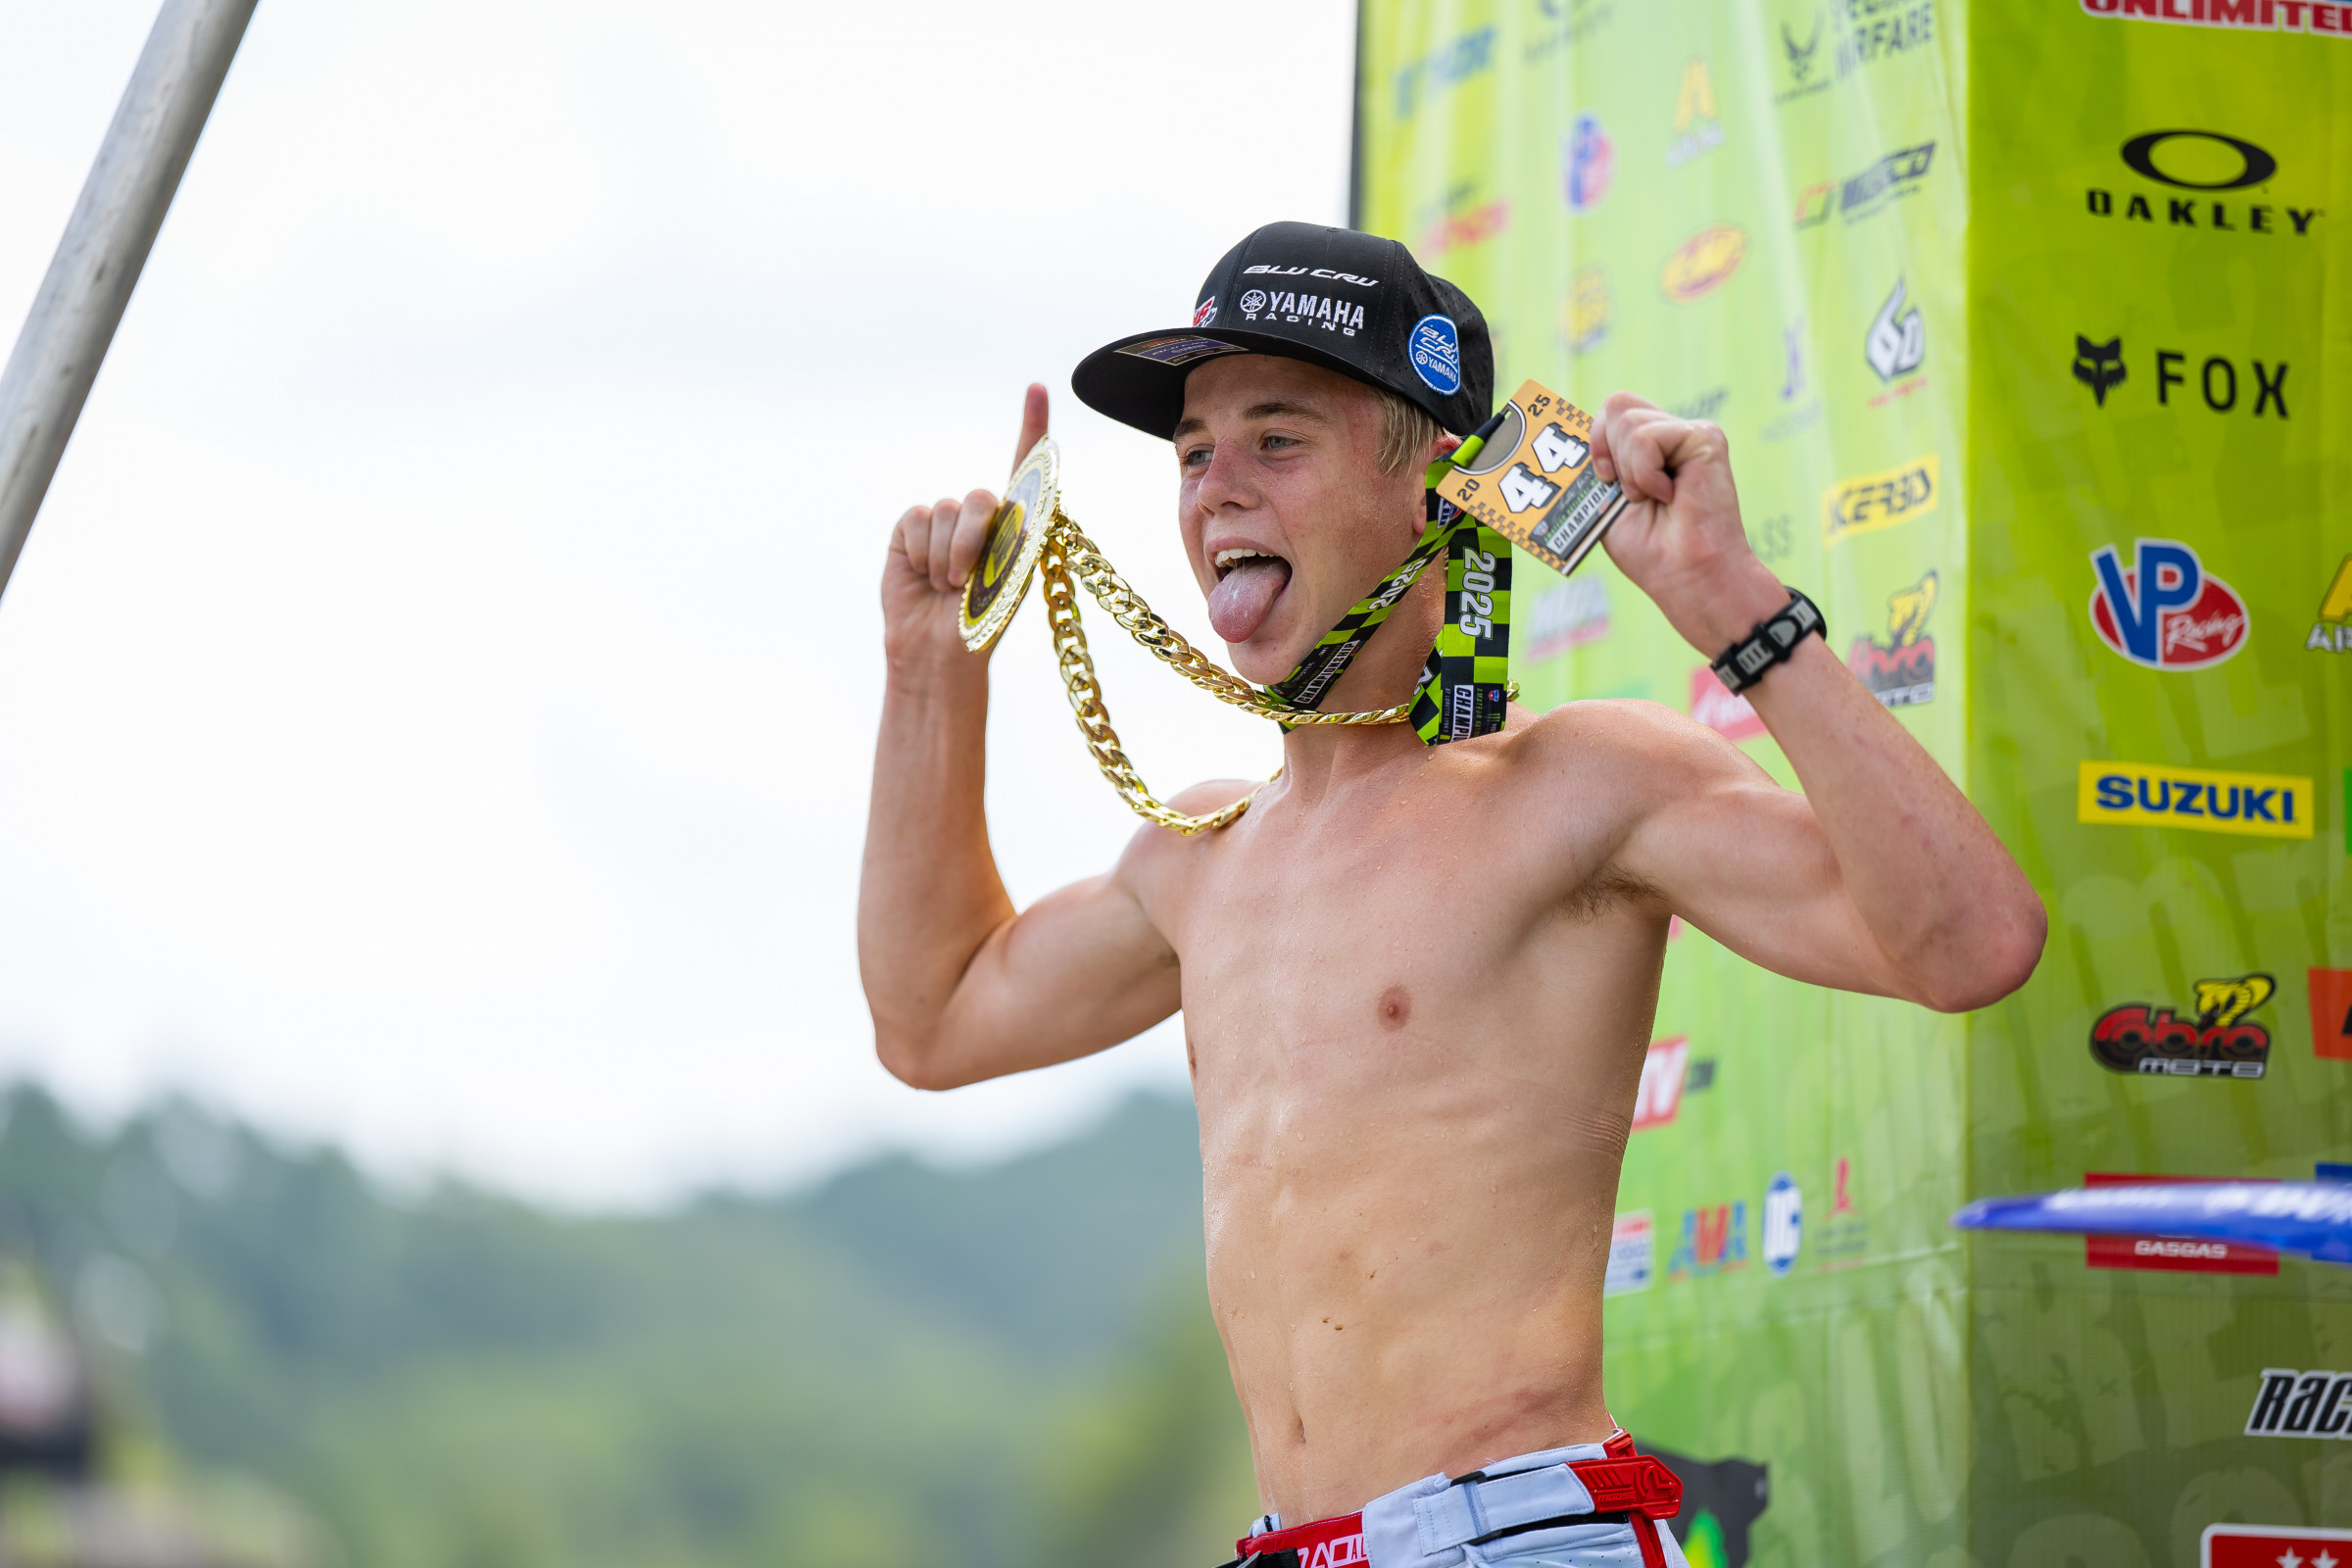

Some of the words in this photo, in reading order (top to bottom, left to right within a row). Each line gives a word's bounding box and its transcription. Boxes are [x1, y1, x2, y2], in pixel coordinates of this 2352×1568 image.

[2086, 188, 2316, 235] OAKLEY
[1243, 265, 1308, 274] BLU
[1309, 269, 1379, 287] CRU
[1245, 313, 1356, 336] RACING
[1269, 291, 1364, 329] YAMAHA
[1527, 394, 1550, 418] 25
[2156, 348, 2289, 419] FOX
[1456, 478, 1481, 502] 20
[1368, 558, 1429, 610] 2025
[1460, 547, 1497, 640] 2025
[2091, 539, 2201, 667] VP
[2165, 610, 2247, 656] Racing
[1297, 643, 1355, 702] CHAMPIONSHIP
[2095, 774, 2295, 823] SUZUKI
[2134, 1240, 2228, 1259] GASGAS
[2246, 1370, 2352, 1437] RaC
[1597, 1491, 1637, 1502] MOOSE
